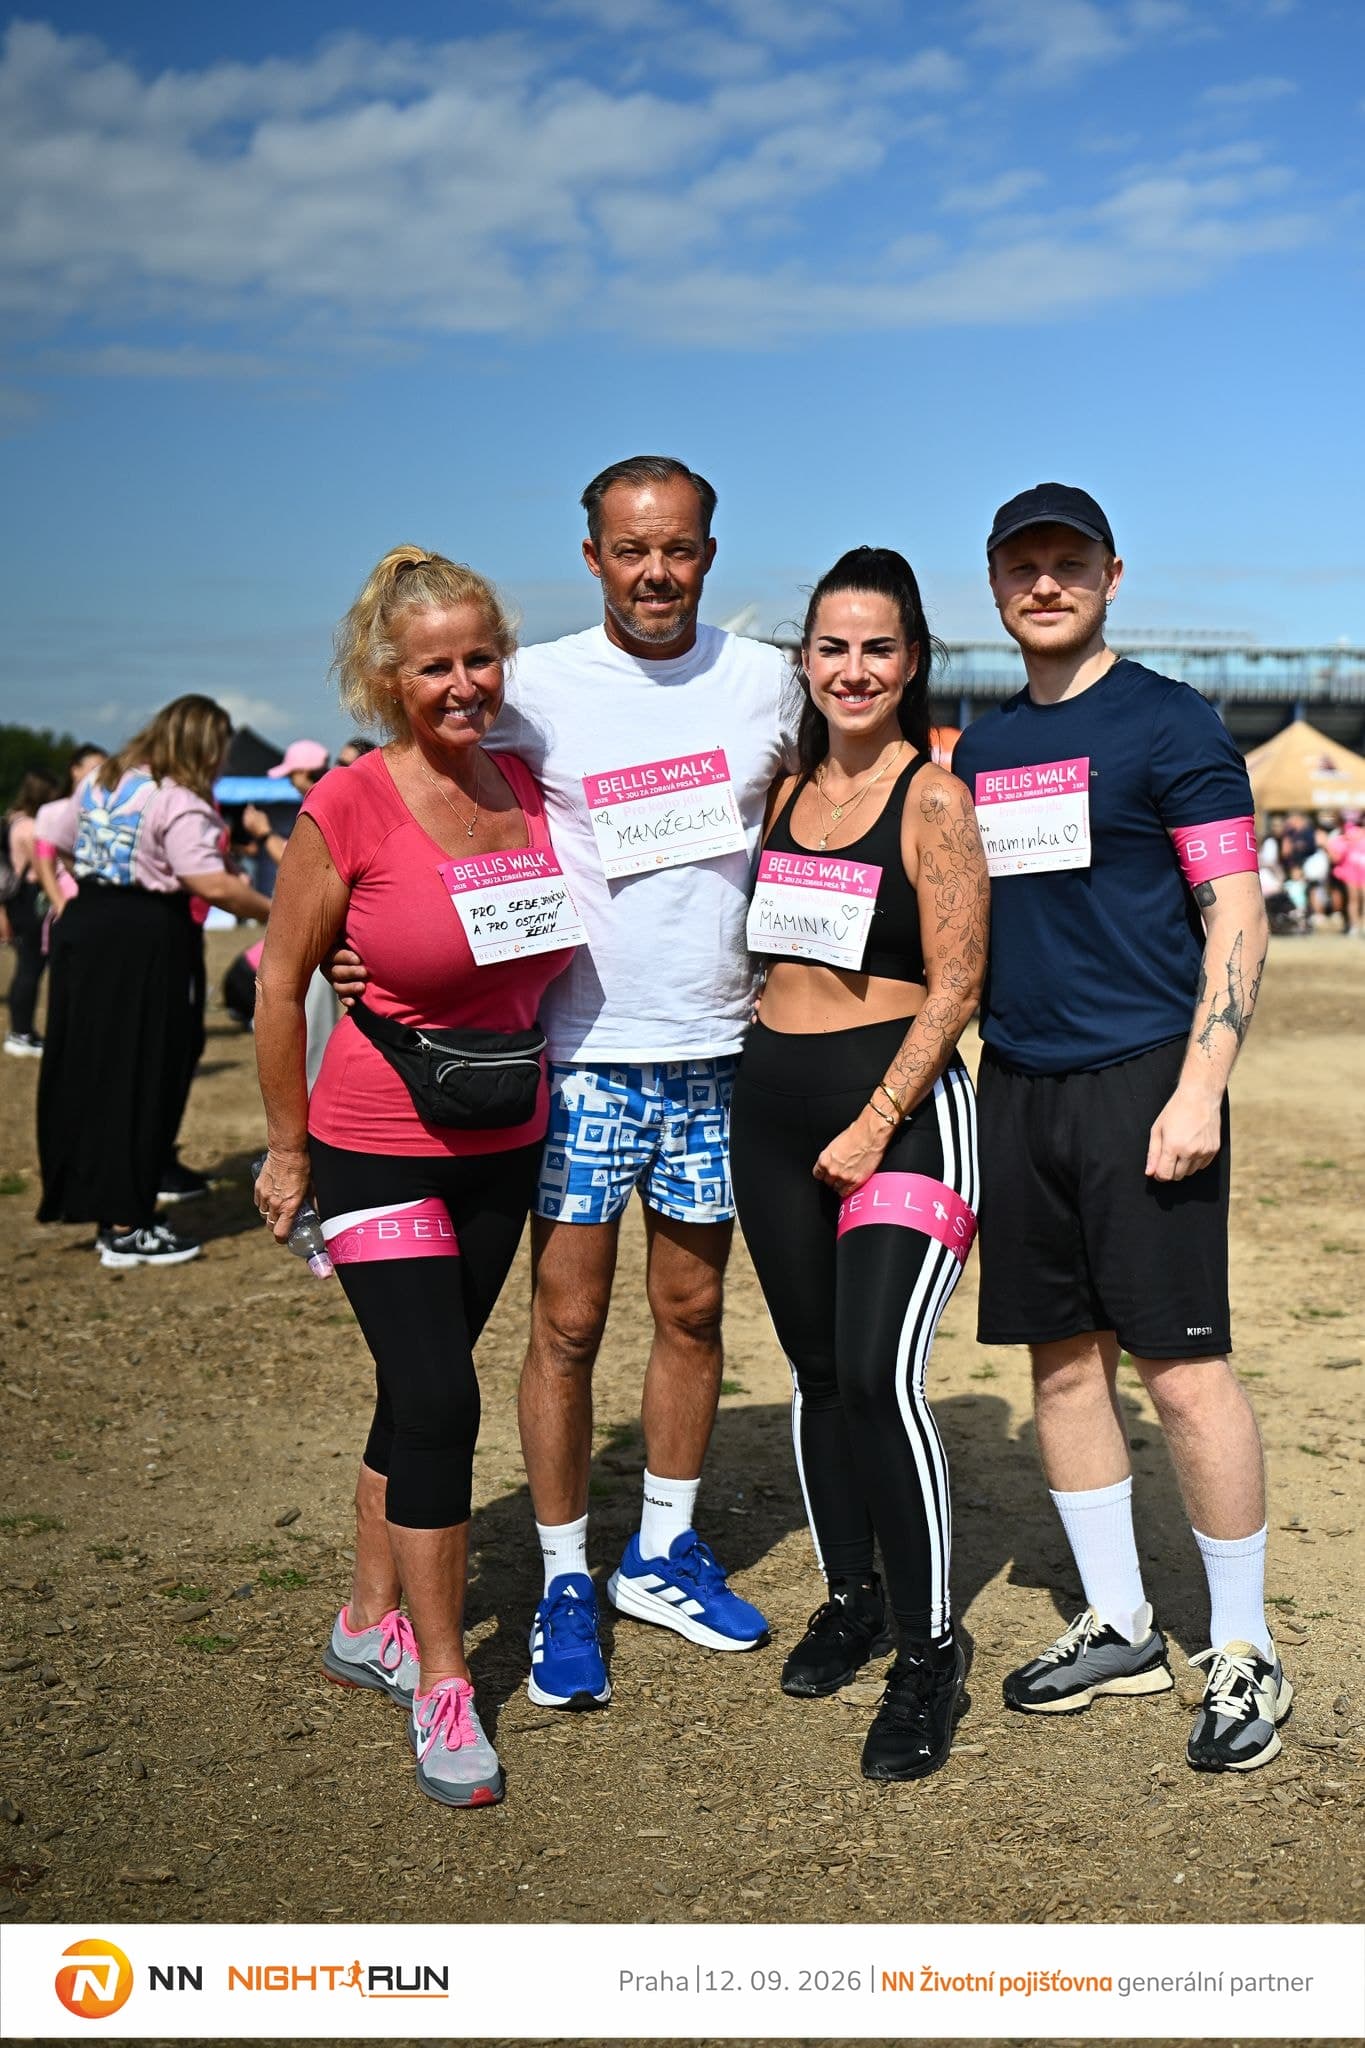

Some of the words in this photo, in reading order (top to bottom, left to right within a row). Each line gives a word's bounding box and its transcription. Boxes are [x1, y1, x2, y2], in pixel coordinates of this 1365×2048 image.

[597, 769, 658, 796] BELLIS
[660, 757, 715, 782] WALK
[985, 773, 1033, 793] BELLIS
[1035, 765, 1078, 785] WALK
[616, 805, 731, 849] MANŽELKU
[986, 825, 1060, 854] maminku
[453, 857, 507, 882] BELLIS
[507, 852, 549, 871] WALK
[768, 857, 816, 877] BELLIS
[819, 863, 868, 885] WALK
[469, 904, 497, 920] PRO
[473, 924, 482, 936] A
[486, 920, 509, 933] PRO
[515, 901, 563, 928] OSTATNÍ
[759, 910, 849, 941] MAMINKU
[525, 922, 557, 938] ŽENY
